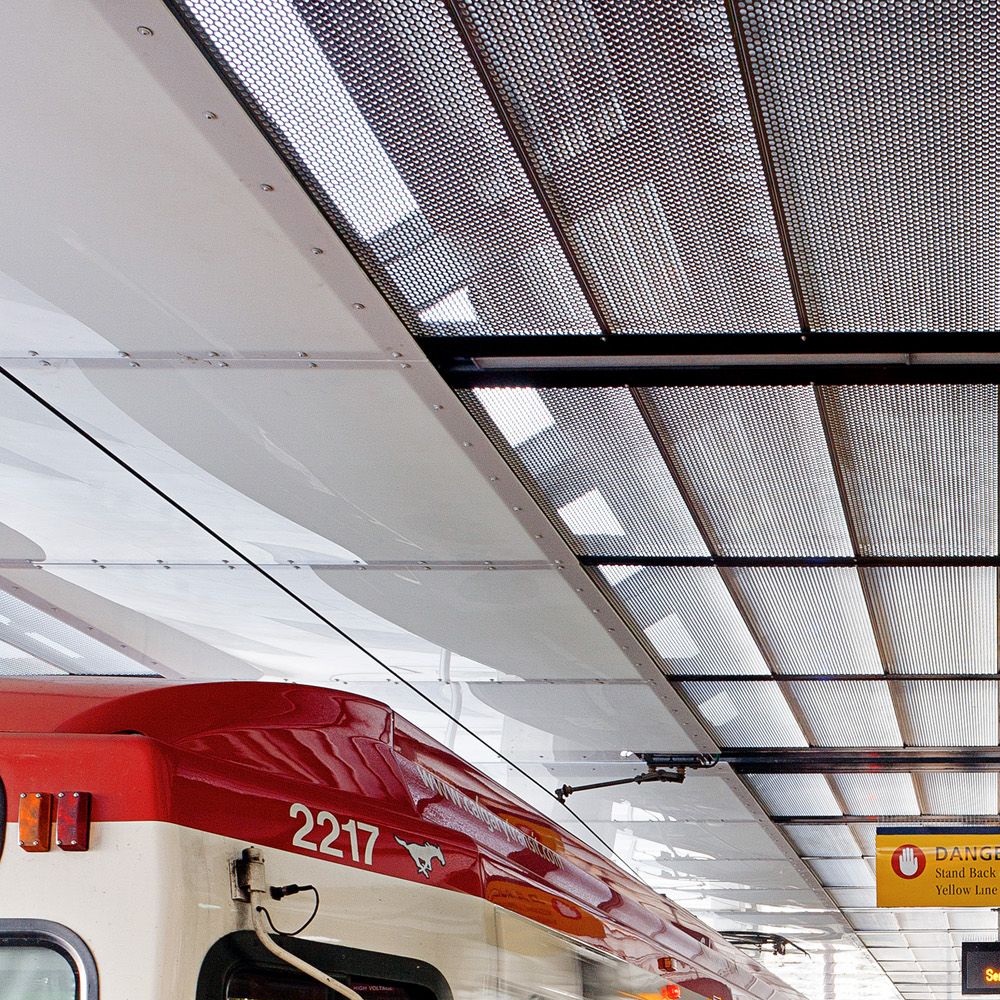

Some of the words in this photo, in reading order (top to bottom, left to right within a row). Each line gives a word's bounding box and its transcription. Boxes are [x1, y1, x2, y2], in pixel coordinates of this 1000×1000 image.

[289, 802, 379, 866] 2217
[935, 867, 965, 879] Stand
[969, 867, 996, 879] Back
[935, 884, 971, 896] Yellow
[975, 884, 998, 895] Line
